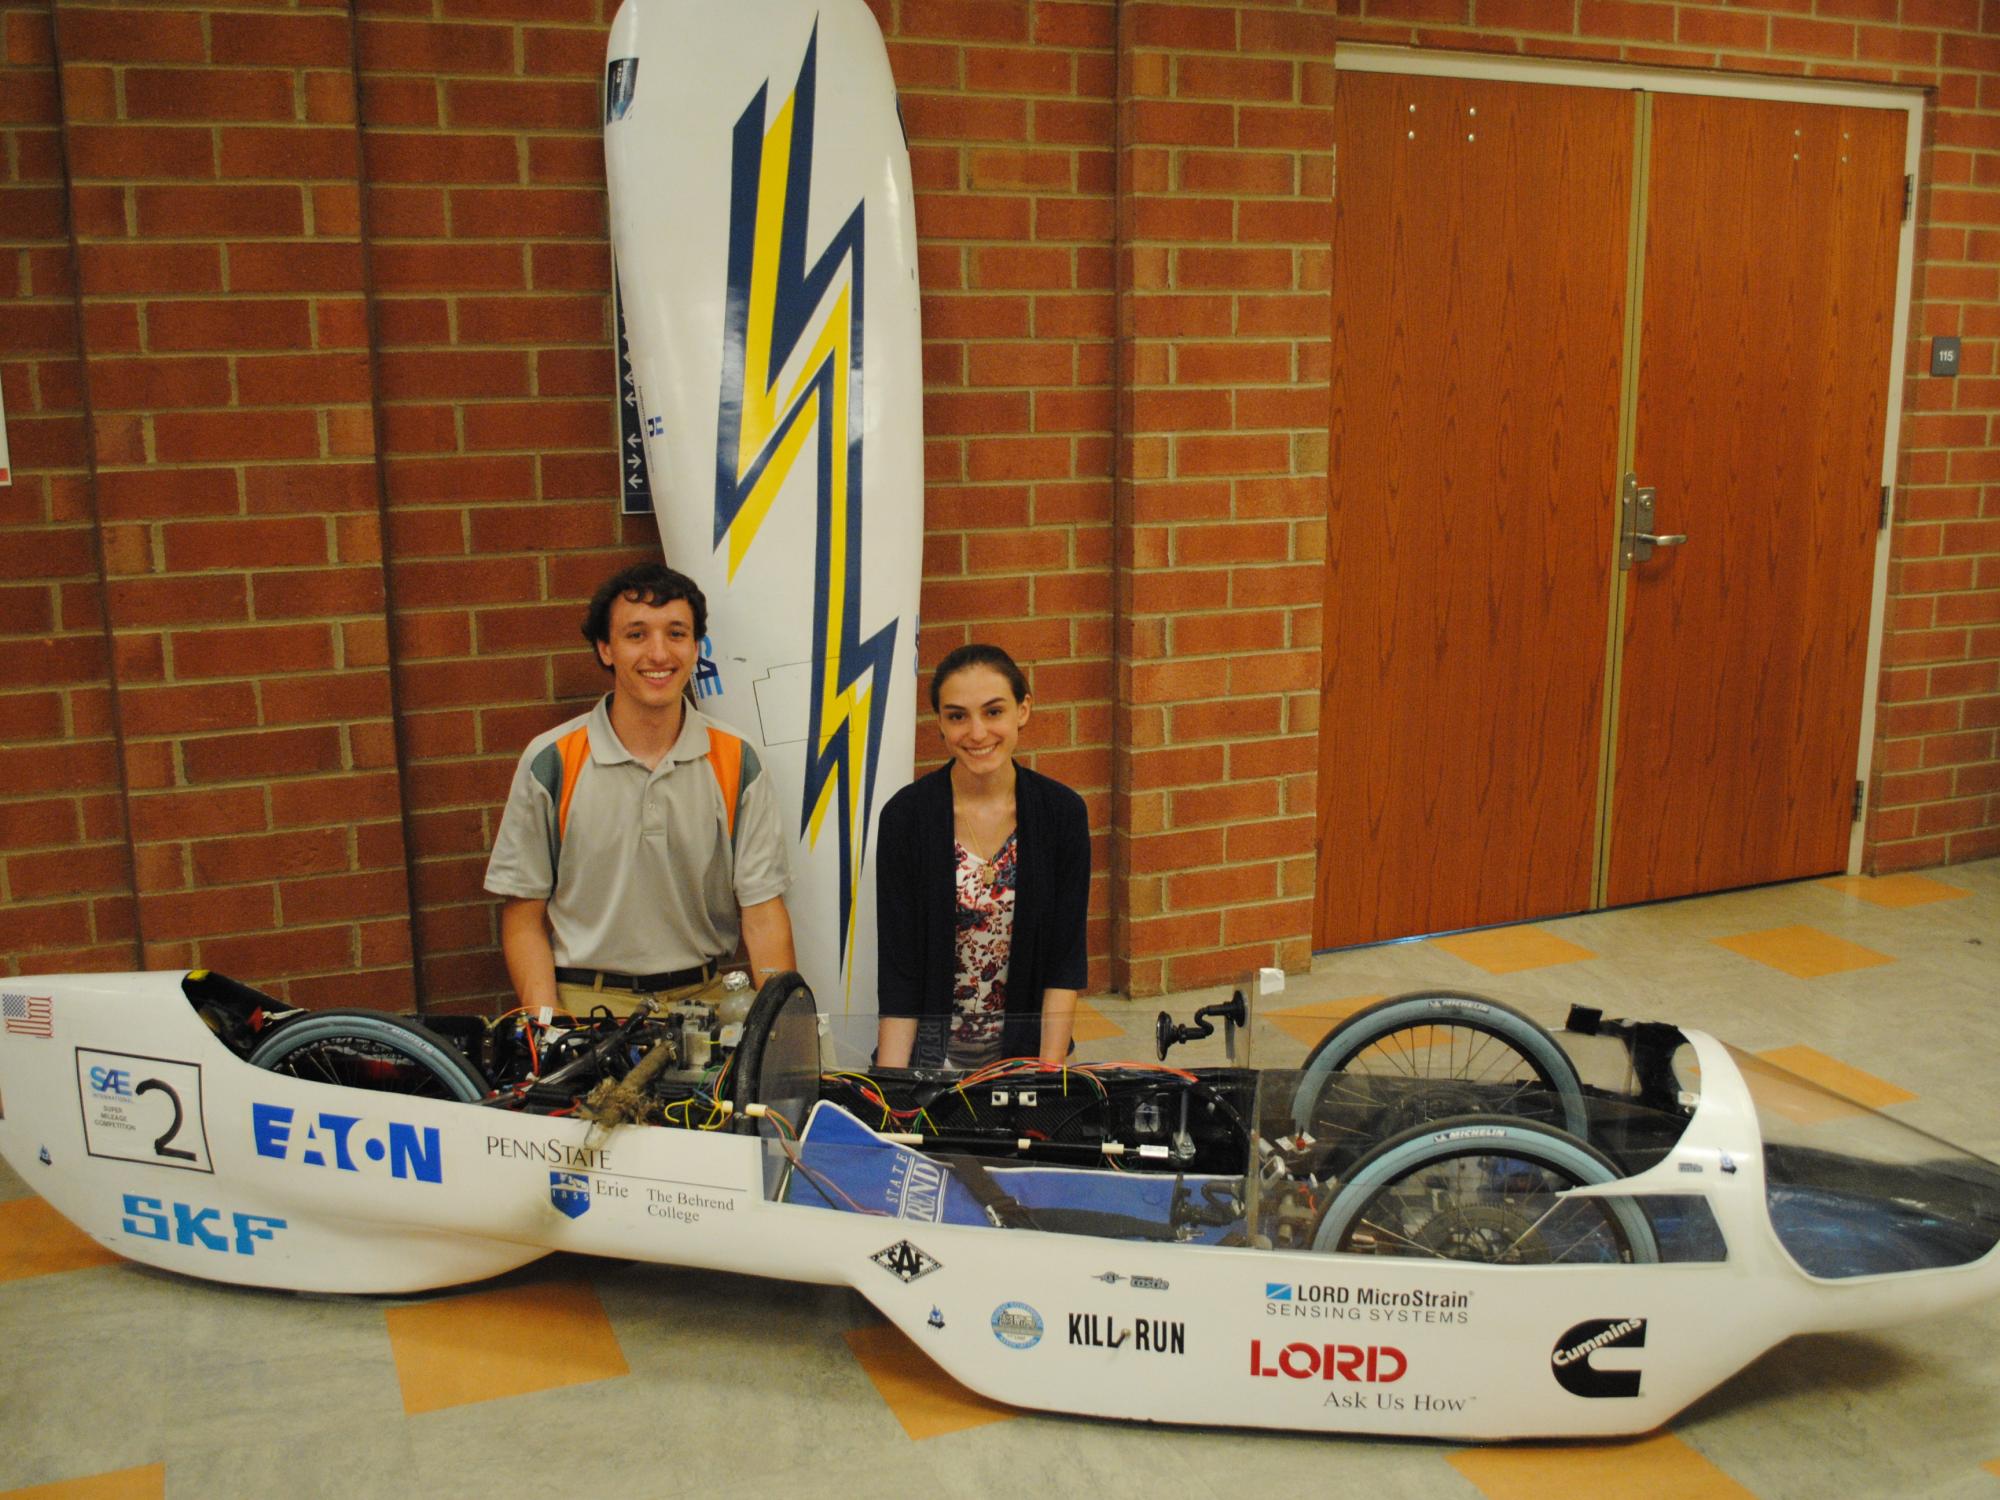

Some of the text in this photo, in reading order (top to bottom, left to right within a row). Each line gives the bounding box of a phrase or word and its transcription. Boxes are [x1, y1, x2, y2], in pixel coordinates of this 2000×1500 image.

[1939, 350, 1954, 362] 115
[90, 1066, 133, 1096] SAE
[100, 1112, 128, 1123] MILEAGE
[103, 1104, 123, 1114] SUPER
[135, 1078, 197, 1162] 2
[94, 1119, 137, 1131] COMPETITION
[1449, 1129, 1505, 1142] MICHELIN
[252, 1103, 443, 1184] EATON
[596, 1180, 629, 1198] Erie
[885, 1153, 908, 1204] STATE
[647, 1188, 735, 1211] The Behrend
[122, 1194, 288, 1256] SKF
[647, 1204, 700, 1223] College
[1298, 1285, 1468, 1308] LORD MicroStrain
[1266, 1303, 1468, 1324] SENSING SYSTEMS
[1069, 1312, 1121, 1349] KILL
[1135, 1318, 1185, 1355] RUN
[1552, 1317, 1642, 1366] Cummins
[1250, 1339, 1408, 1383] LORD
[1323, 1391, 1467, 1411] Ask Us How
